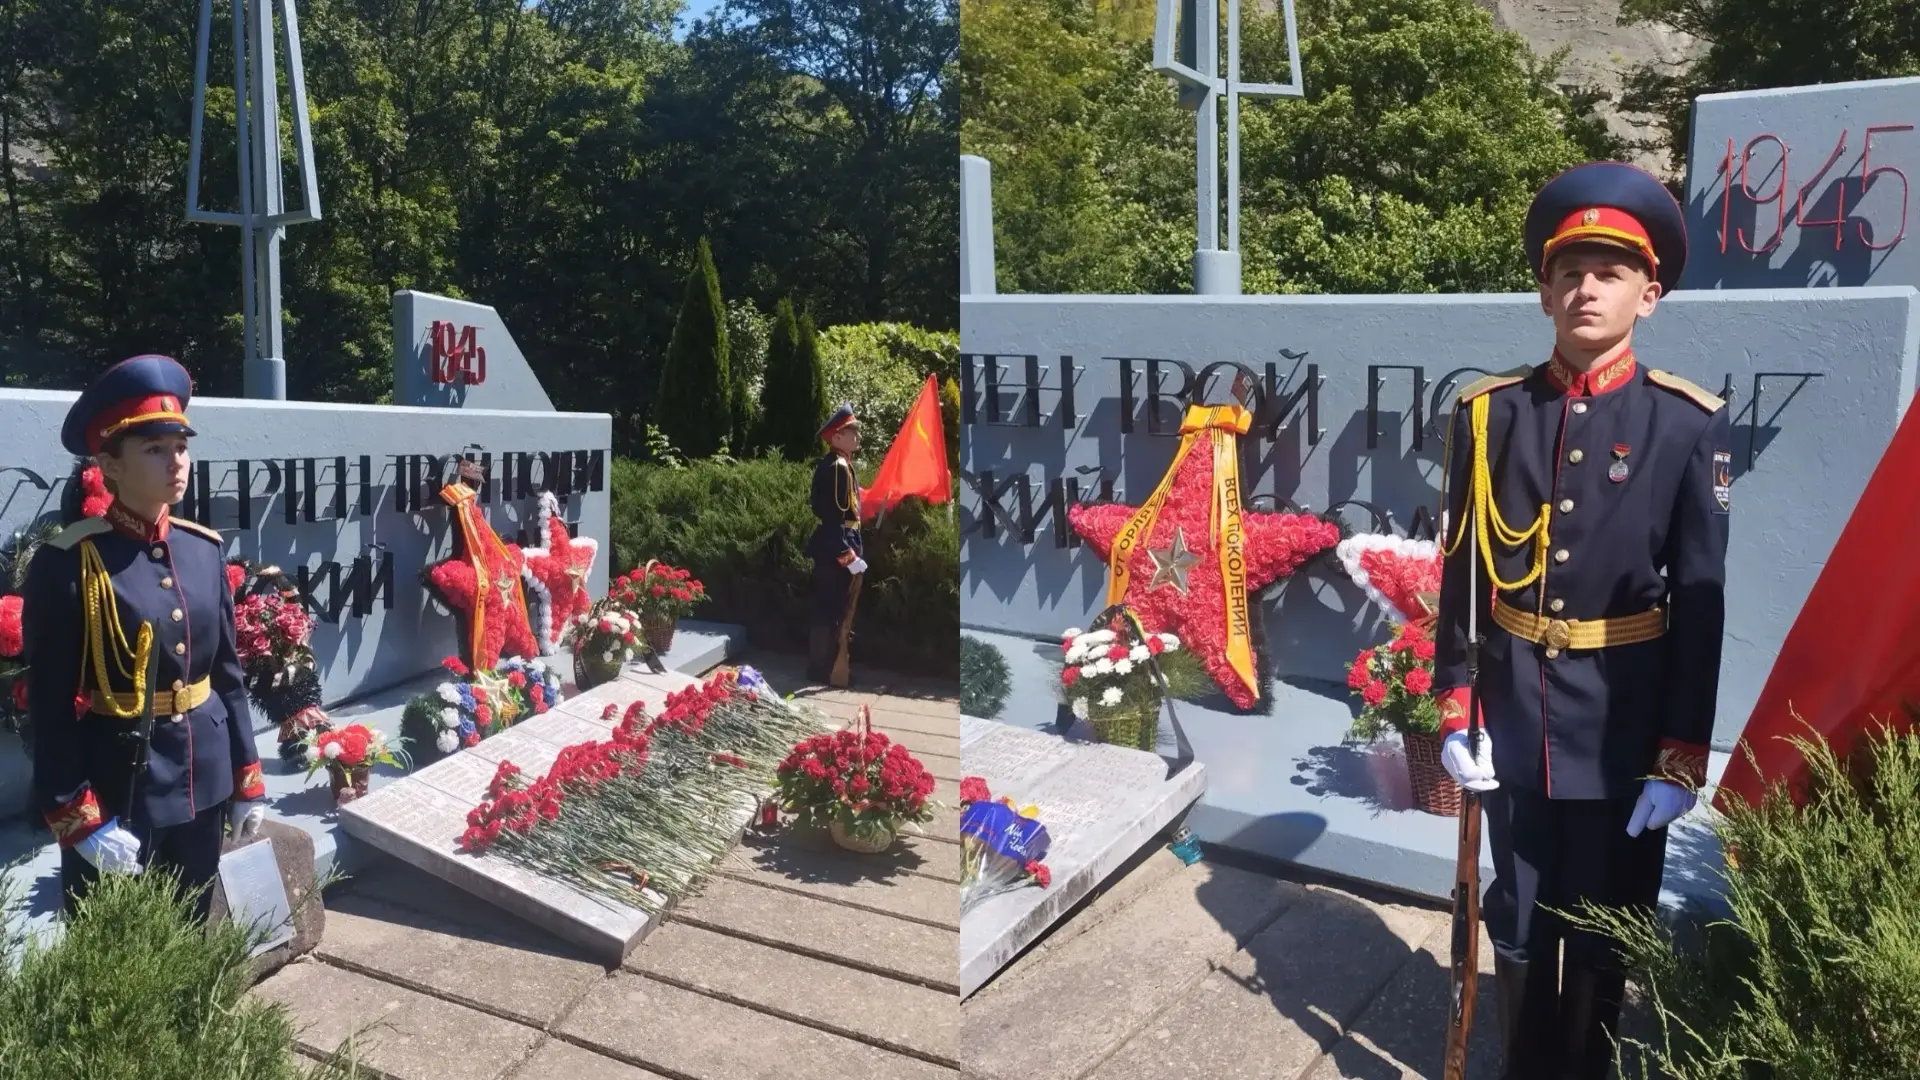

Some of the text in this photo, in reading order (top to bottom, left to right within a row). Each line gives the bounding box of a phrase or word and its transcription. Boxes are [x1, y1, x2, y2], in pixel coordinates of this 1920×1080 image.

[1716, 125, 1914, 255] 1945
[1101, 348, 1319, 446] ТВОЙ
[1224, 477, 1239, 519] ВСЕХ
